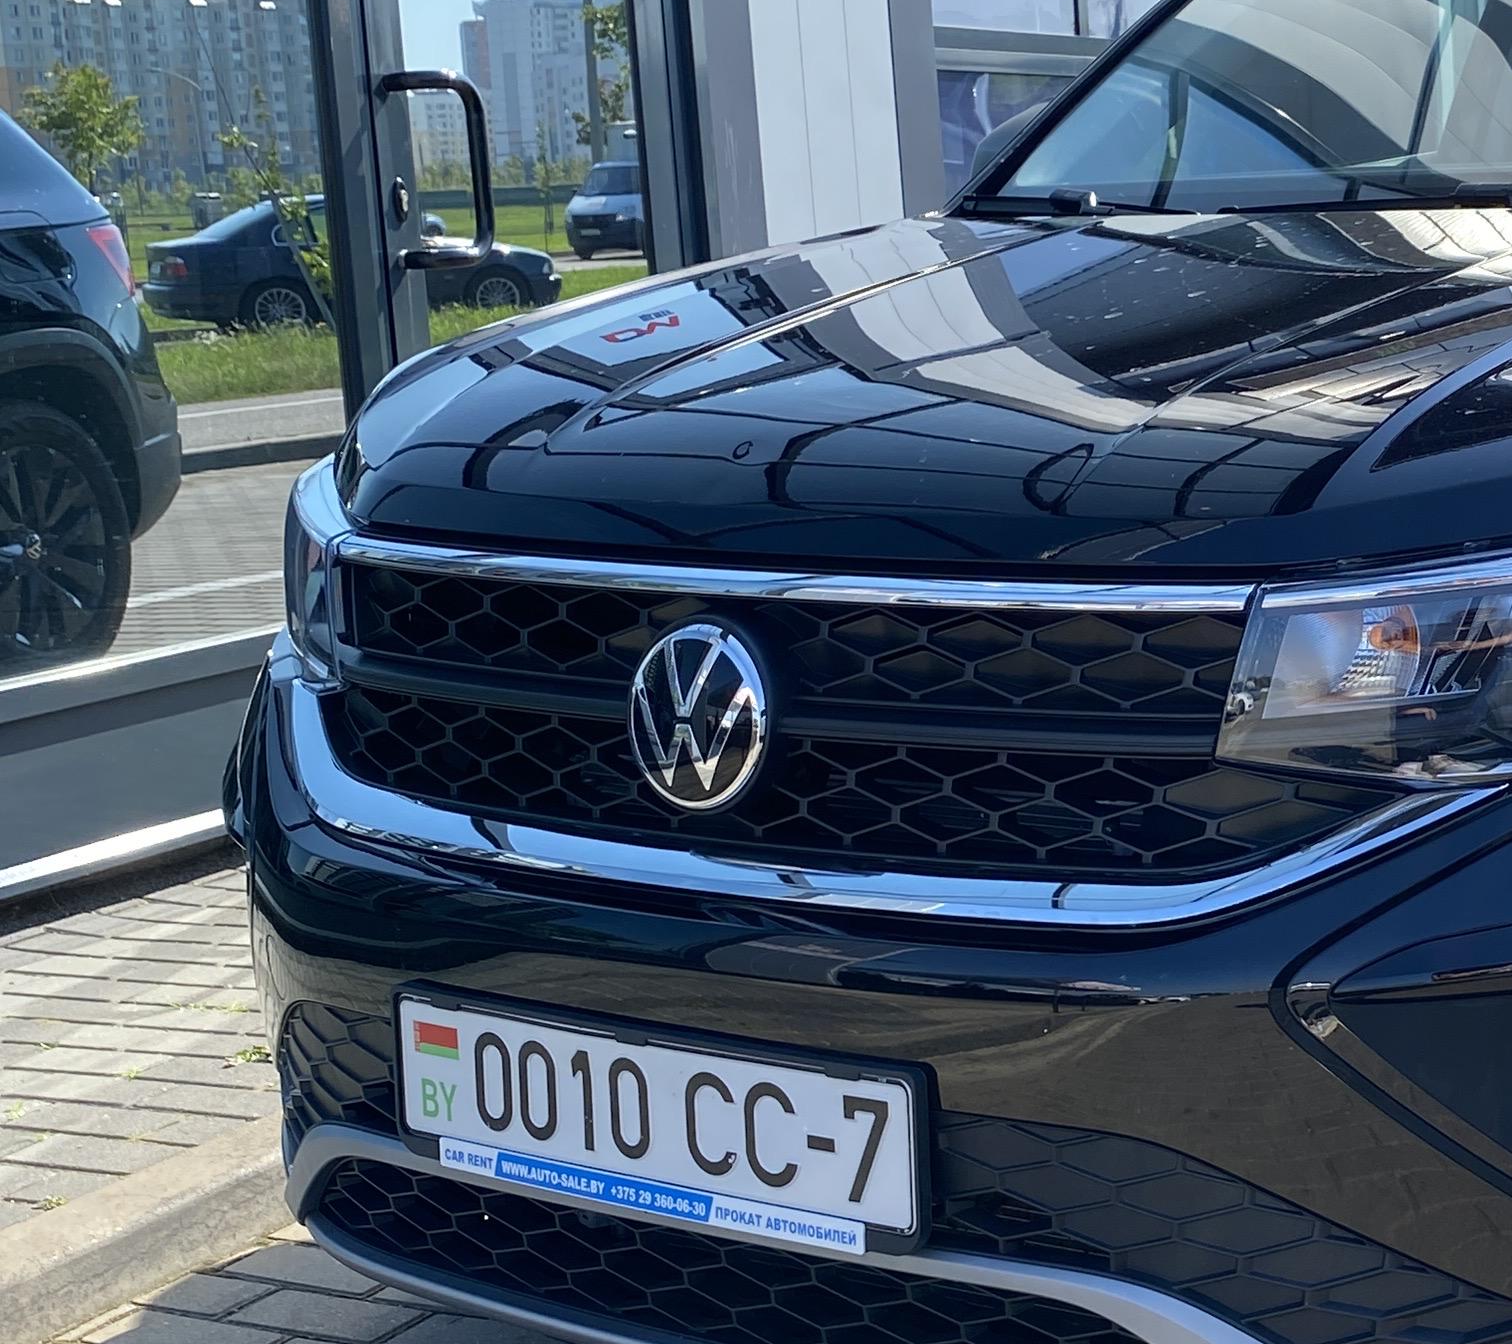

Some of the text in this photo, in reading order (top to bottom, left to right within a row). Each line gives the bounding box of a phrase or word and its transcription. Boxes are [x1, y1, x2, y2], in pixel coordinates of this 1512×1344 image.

[422, 1077, 458, 1122] BY
[474, 1031, 889, 1203] 0010 CC-7
[444, 1148, 494, 1170] CAR RENT
[501, 1160, 706, 1217] WWW.AUTO-SALE.BY +375 29 360-06-30
[714, 1206, 857, 1246] ПРОКАТ АВТОМОБИЛЕЙ
